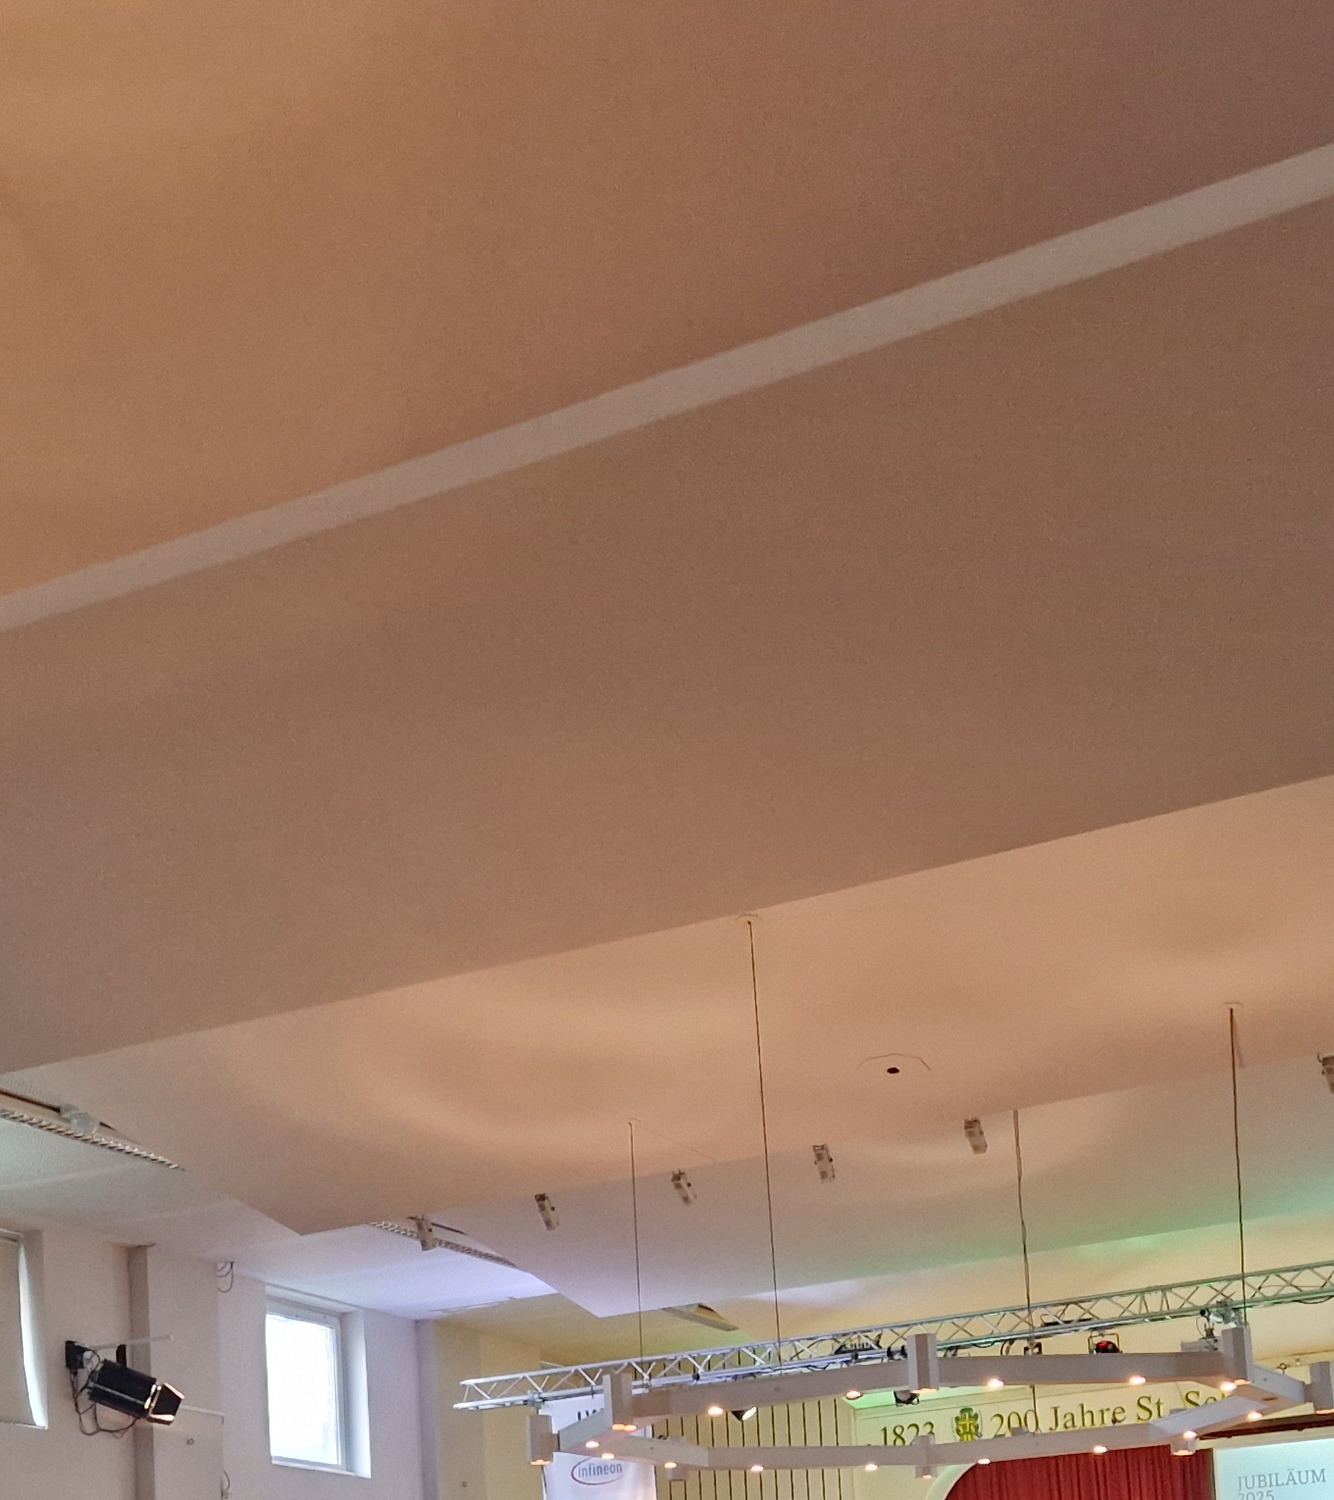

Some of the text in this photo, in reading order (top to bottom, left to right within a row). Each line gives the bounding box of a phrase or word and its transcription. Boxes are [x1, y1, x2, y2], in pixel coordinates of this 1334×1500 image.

[1049, 1402, 1127, 1432] Jahre
[578, 1462, 623, 1479] infineon
[1237, 1468, 1327, 1492] JUBILÄUM
